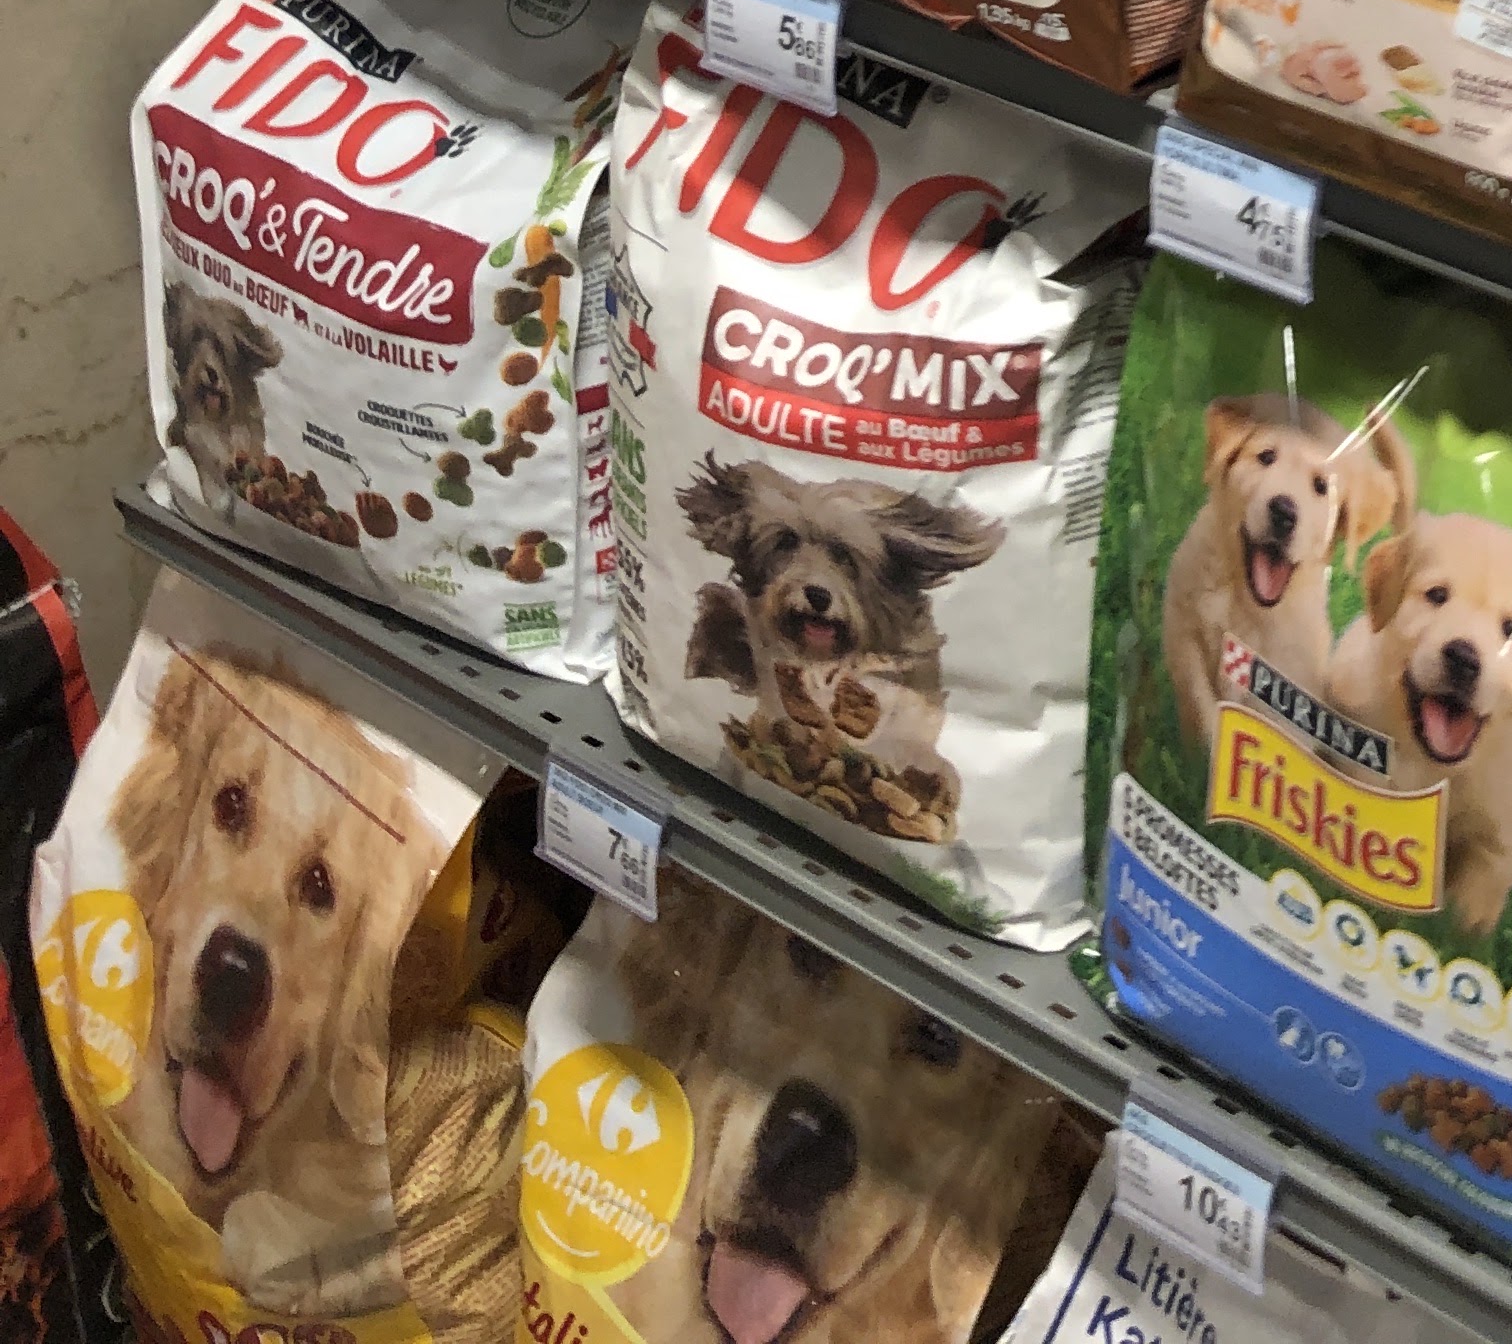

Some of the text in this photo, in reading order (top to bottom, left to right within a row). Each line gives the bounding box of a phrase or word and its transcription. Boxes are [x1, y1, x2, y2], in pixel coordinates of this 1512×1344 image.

[170, 1, 452, 188] FIDO
[203, 252, 435, 373] DUO BŒUF VOLAILLE
[257, 201, 288, 259] &
[291, 196, 458, 326] Tendre
[704, 378, 849, 452] ADULTE
[888, 417, 963, 444] Bœuf
[713, 307, 1022, 411] CROQ'MIX
[901, 438, 1025, 469] Légumes
[1251, 662, 1388, 774] PURINA
[1229, 730, 1423, 892] Friskies
[1117, 863, 1205, 960] Junior
